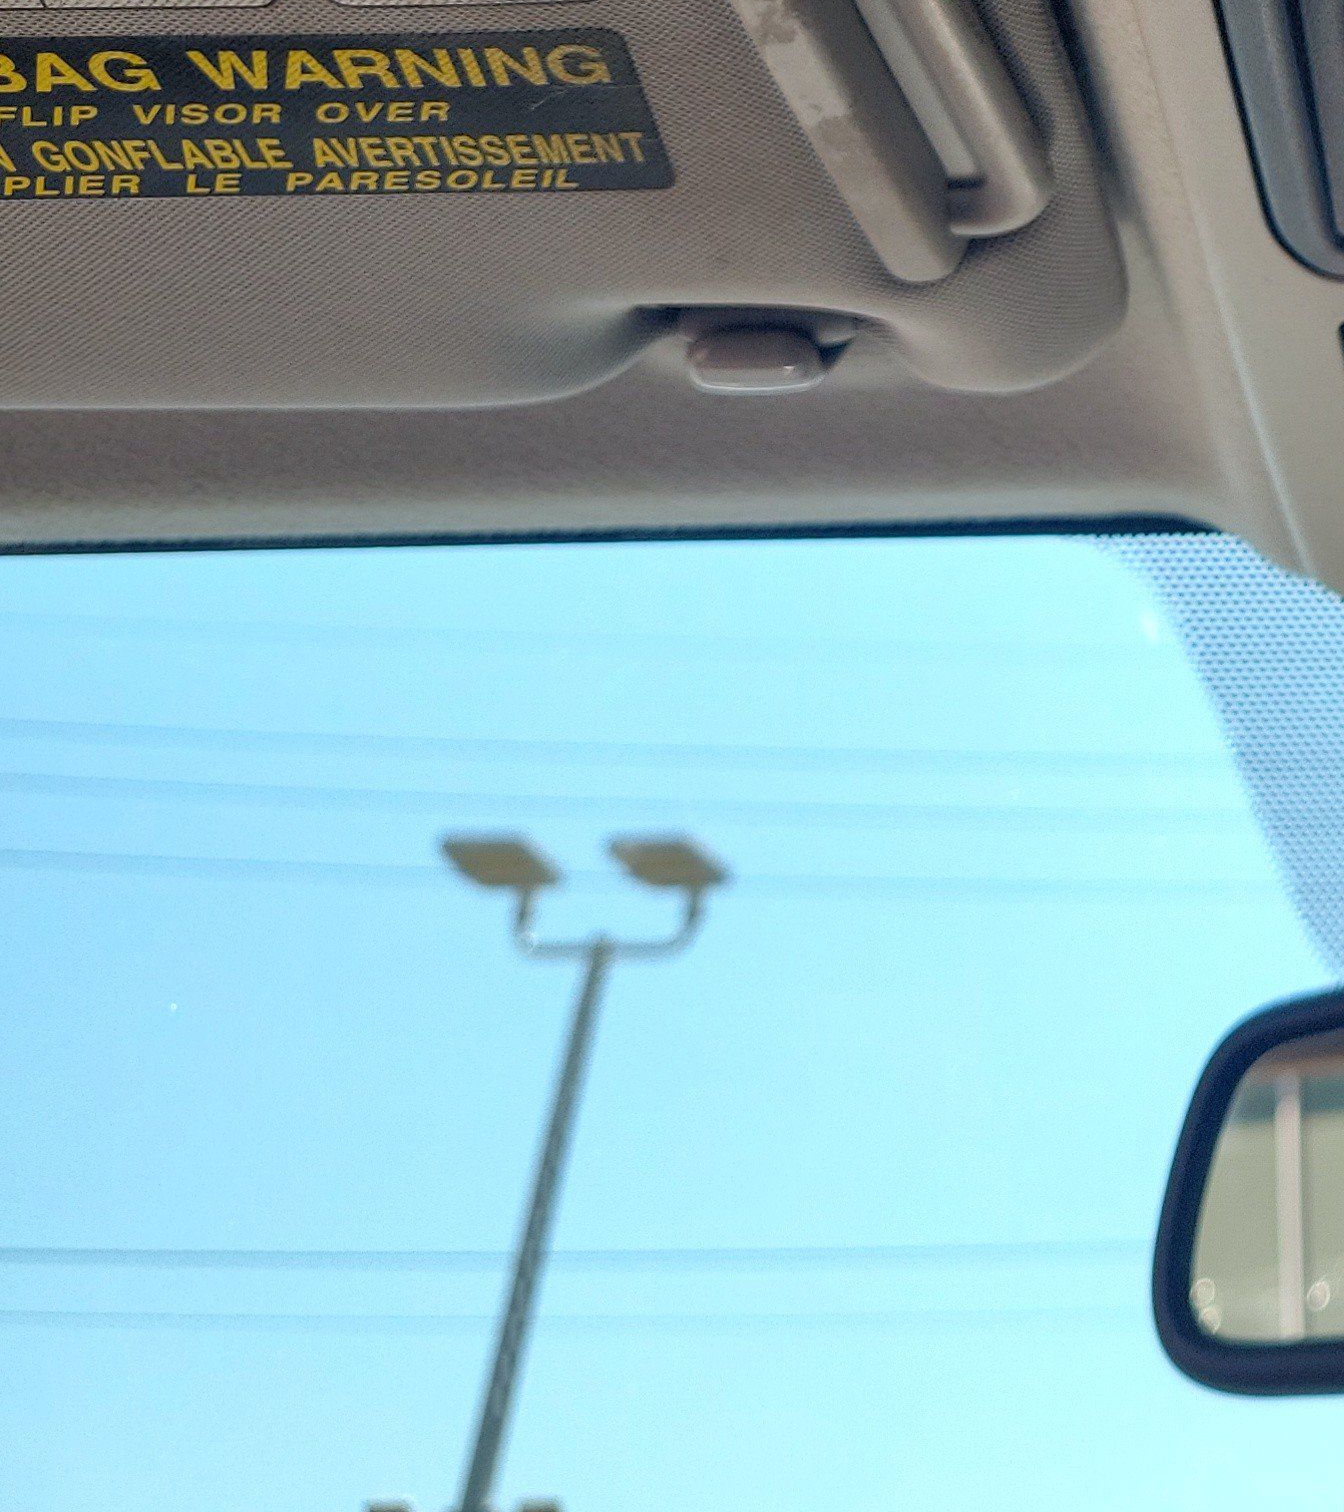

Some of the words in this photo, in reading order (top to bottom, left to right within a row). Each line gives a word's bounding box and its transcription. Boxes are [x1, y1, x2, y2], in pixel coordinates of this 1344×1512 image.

[185, 43, 612, 90] WARNING
[132, 103, 282, 125] VISOR
[315, 101, 451, 124] OVER
[31, 139, 294, 173] GONFLABLE
[312, 131, 647, 168] AVERTISSEMENT
[4, 174, 141, 196] PLIER
[186, 173, 244, 195] LE
[285, 169, 580, 192] PARESOLEIL
